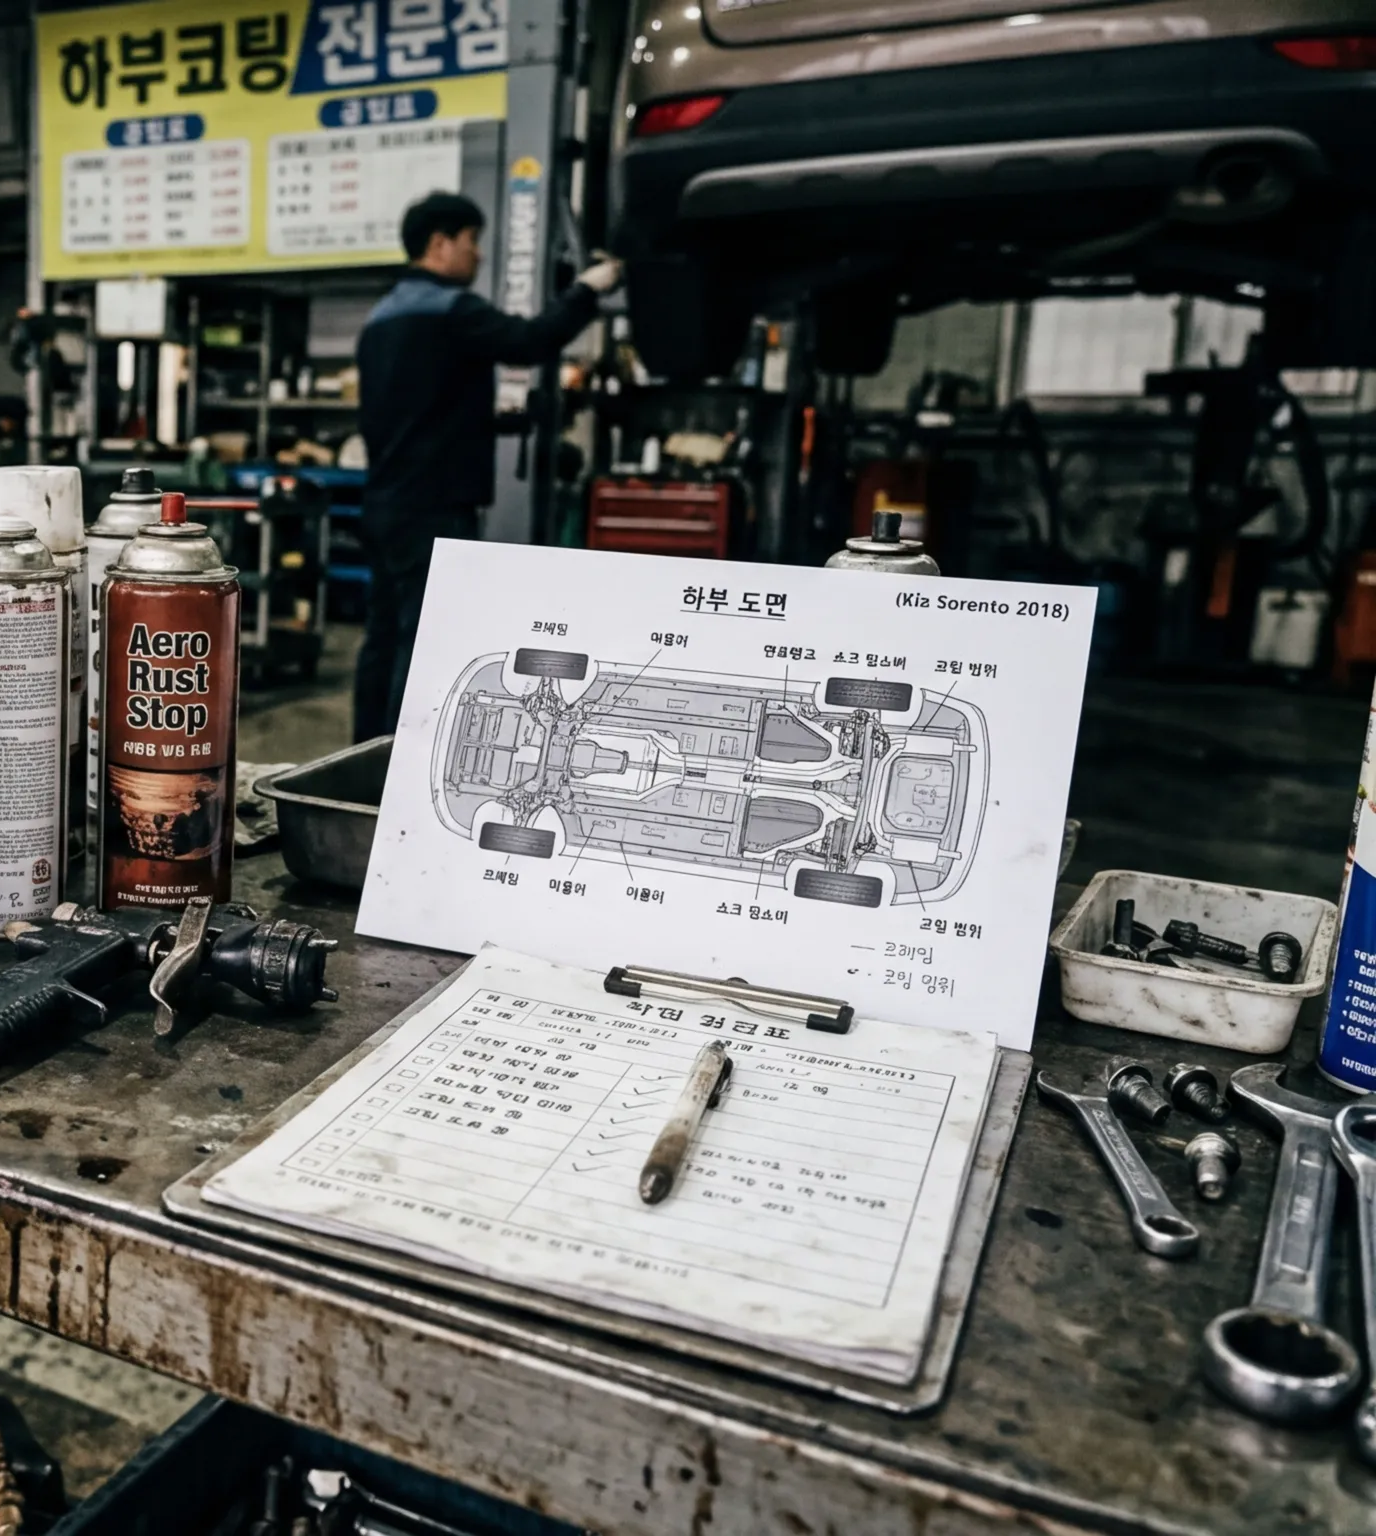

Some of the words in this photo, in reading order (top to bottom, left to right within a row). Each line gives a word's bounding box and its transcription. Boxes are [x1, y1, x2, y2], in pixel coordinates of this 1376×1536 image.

[58, 13, 291, 109] 하부코팅
[683, 586, 729, 612] 하부
[738, 592, 788, 617] 도면
[936, 595, 1010, 616] Sorento
[1016, 601, 1070, 622] 2018)
[127, 623, 211, 659] Aero
[128, 658, 209, 695] Rust
[126, 694, 208, 737] Stop
